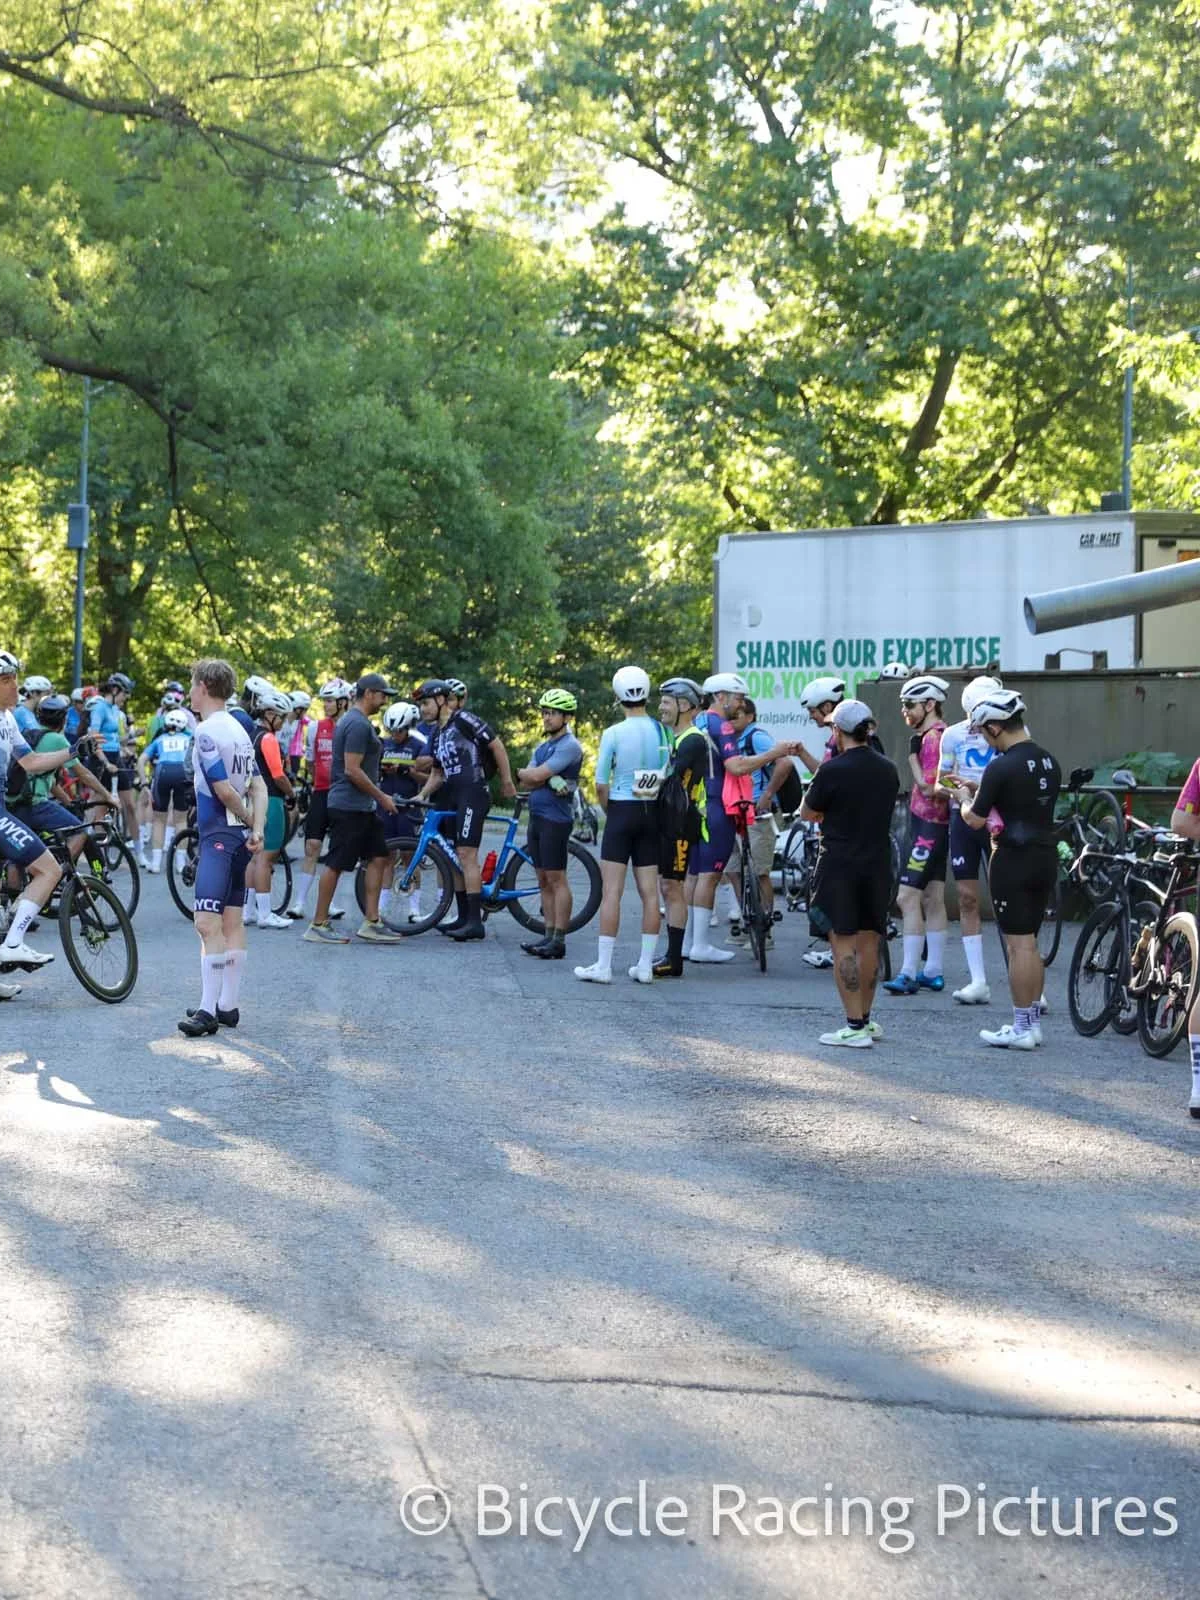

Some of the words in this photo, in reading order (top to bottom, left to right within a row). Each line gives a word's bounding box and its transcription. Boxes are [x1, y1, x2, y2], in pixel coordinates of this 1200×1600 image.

[736, 640, 826, 668] SHARING
[832, 638, 877, 668] OUR
[883, 636, 1001, 668] EXPERTISE
[738, 670, 775, 700] OR
[781, 670, 834, 700] YO
[1027, 759, 1036, 773] P
[1042, 757, 1053, 771] N
[1039, 777, 1048, 790] S
[907, 835, 937, 873] KCX
